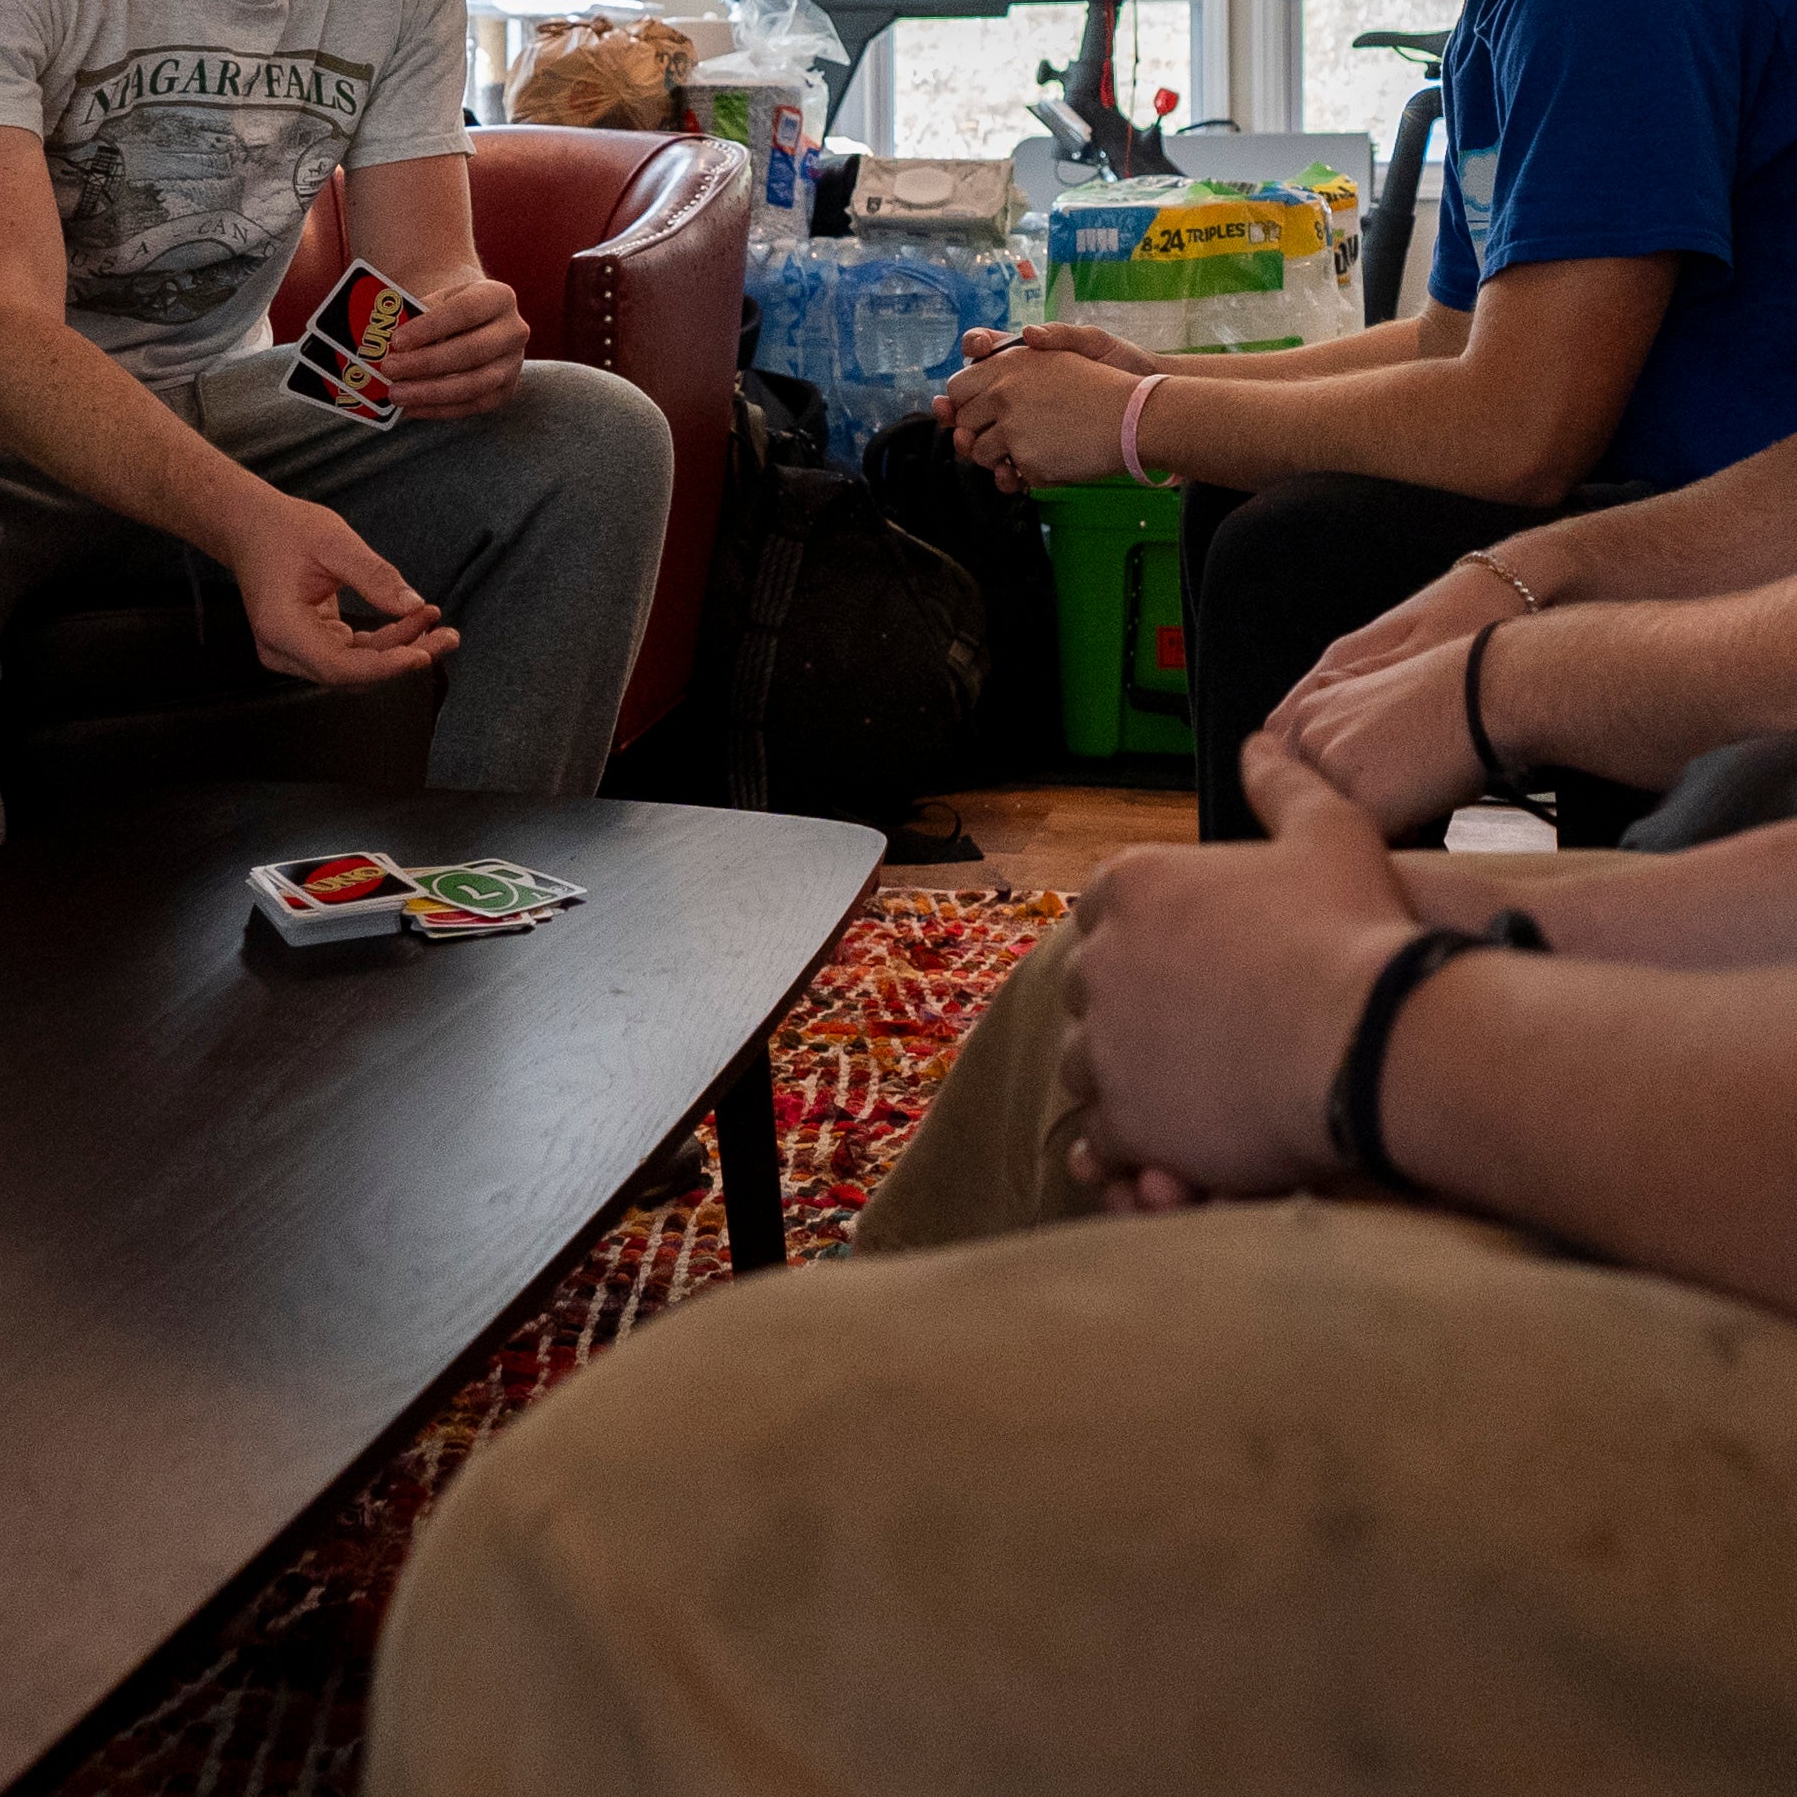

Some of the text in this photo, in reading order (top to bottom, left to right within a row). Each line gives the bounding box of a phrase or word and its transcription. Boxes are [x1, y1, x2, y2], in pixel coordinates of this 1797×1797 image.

[82, 59, 262, 124] NIAGAR
[1187, 223, 1246, 244] TRIPLES
[358, 289, 403, 359] UNO
[301, 866, 386, 894] UNO
